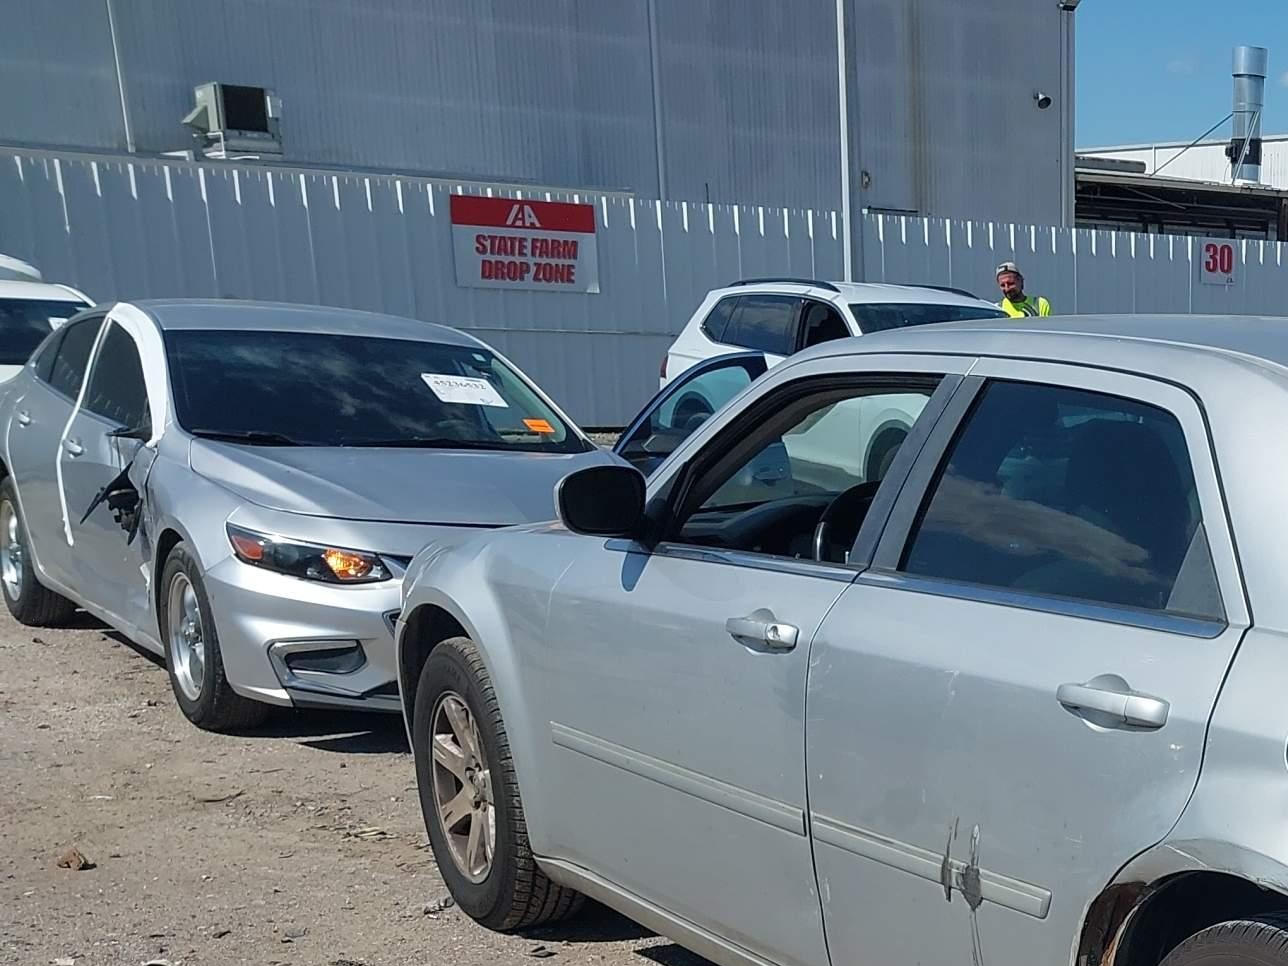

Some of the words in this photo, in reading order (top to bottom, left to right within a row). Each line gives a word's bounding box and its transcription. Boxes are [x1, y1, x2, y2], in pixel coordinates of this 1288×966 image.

[475, 234, 528, 257] STATE
[530, 237, 579, 261] FARM
[1205, 243, 1233, 274] 30
[481, 259, 531, 283] DROP
[531, 262, 577, 285] ZONE
